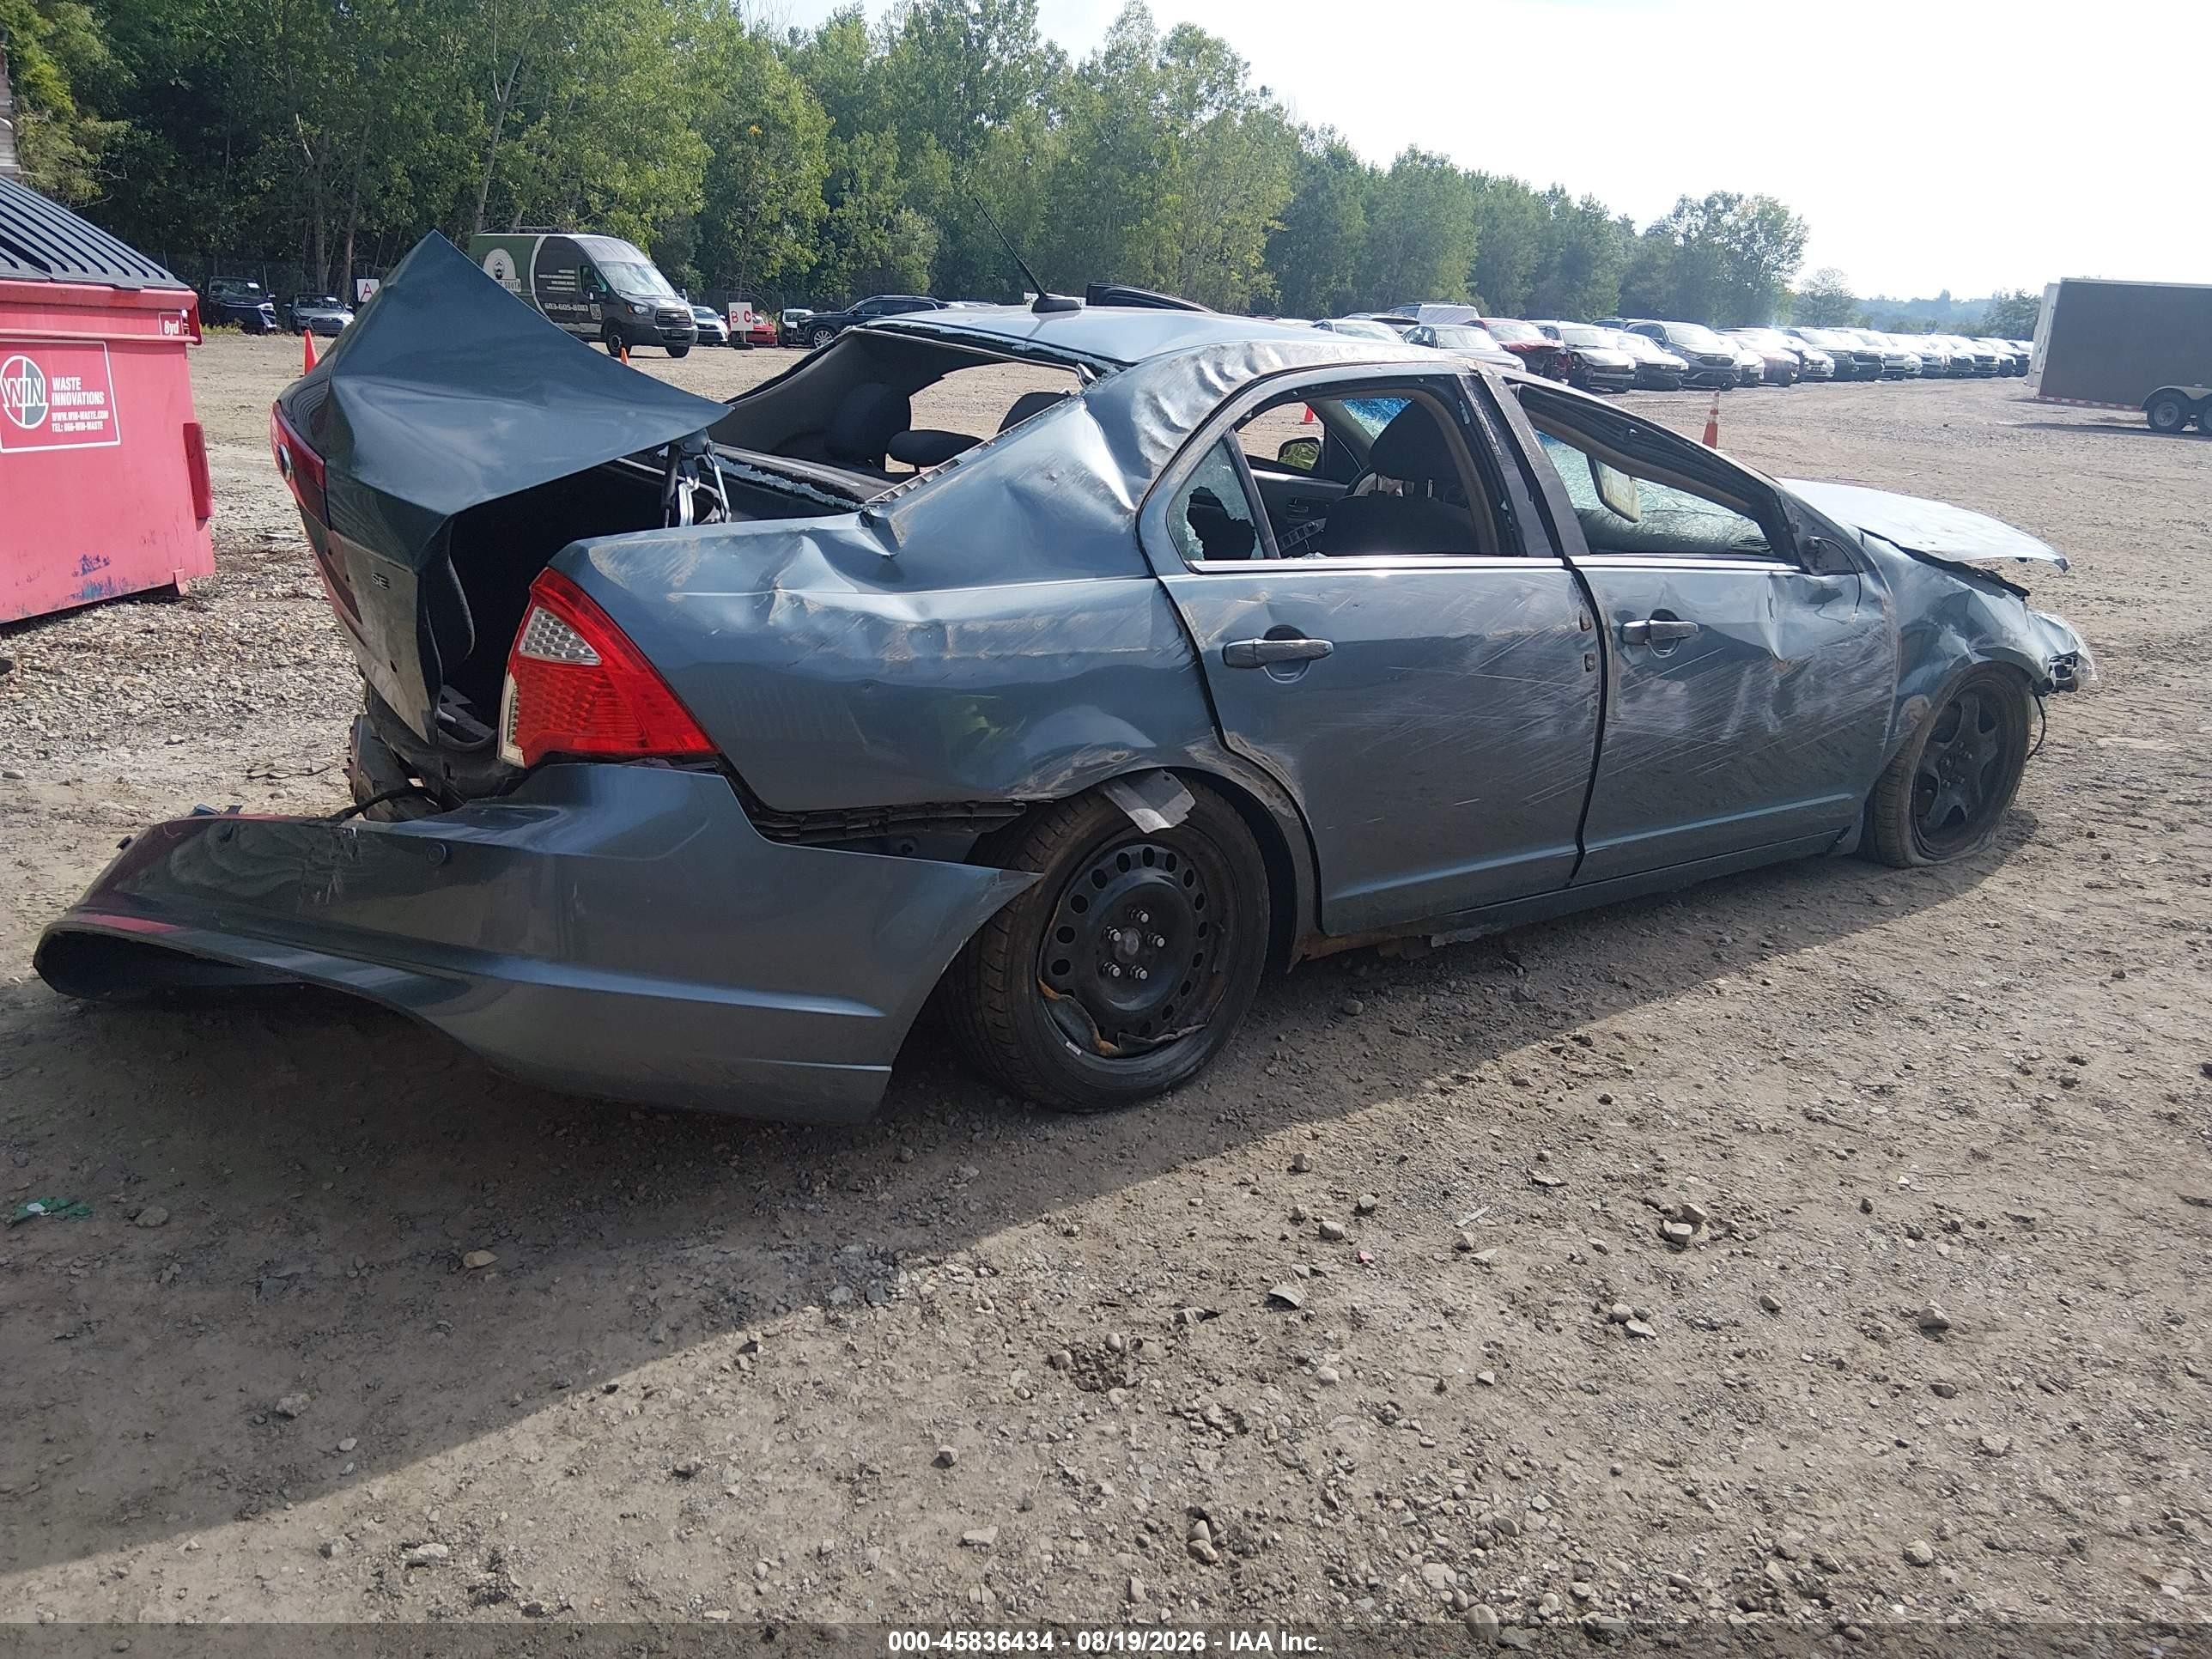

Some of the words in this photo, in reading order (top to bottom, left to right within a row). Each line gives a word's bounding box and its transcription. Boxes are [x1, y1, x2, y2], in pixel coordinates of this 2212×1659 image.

[360, 283, 373, 301] A
[731, 310, 738, 323] B
[744, 310, 751, 323] C
[52, 376, 82, 392] WASTE
[52, 391, 105, 406] INNOVATIONS
[371, 572, 388, 590] SE
